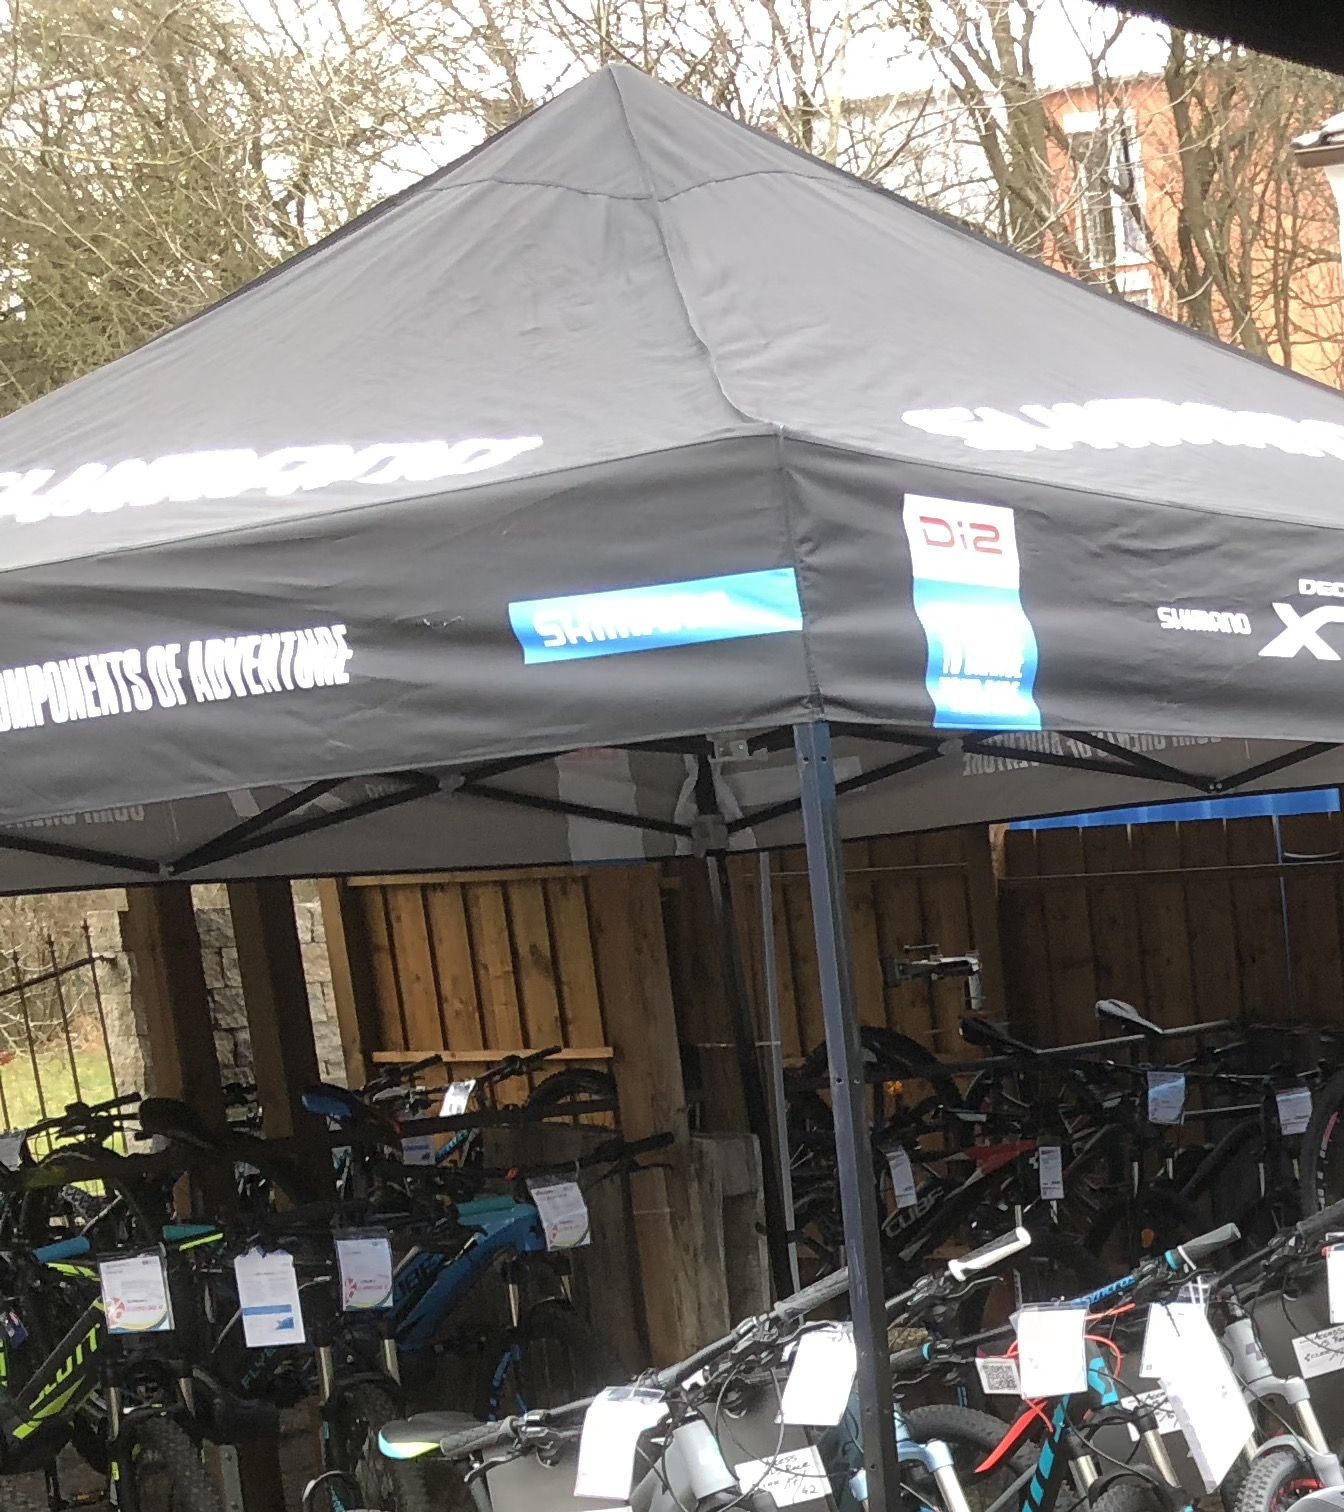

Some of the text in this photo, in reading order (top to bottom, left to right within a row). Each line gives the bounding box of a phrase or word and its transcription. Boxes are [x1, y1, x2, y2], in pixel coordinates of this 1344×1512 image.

[919, 516, 1003, 555] Di2
[0, 624, 353, 732] OMPONENTS OF ADVENTURE
